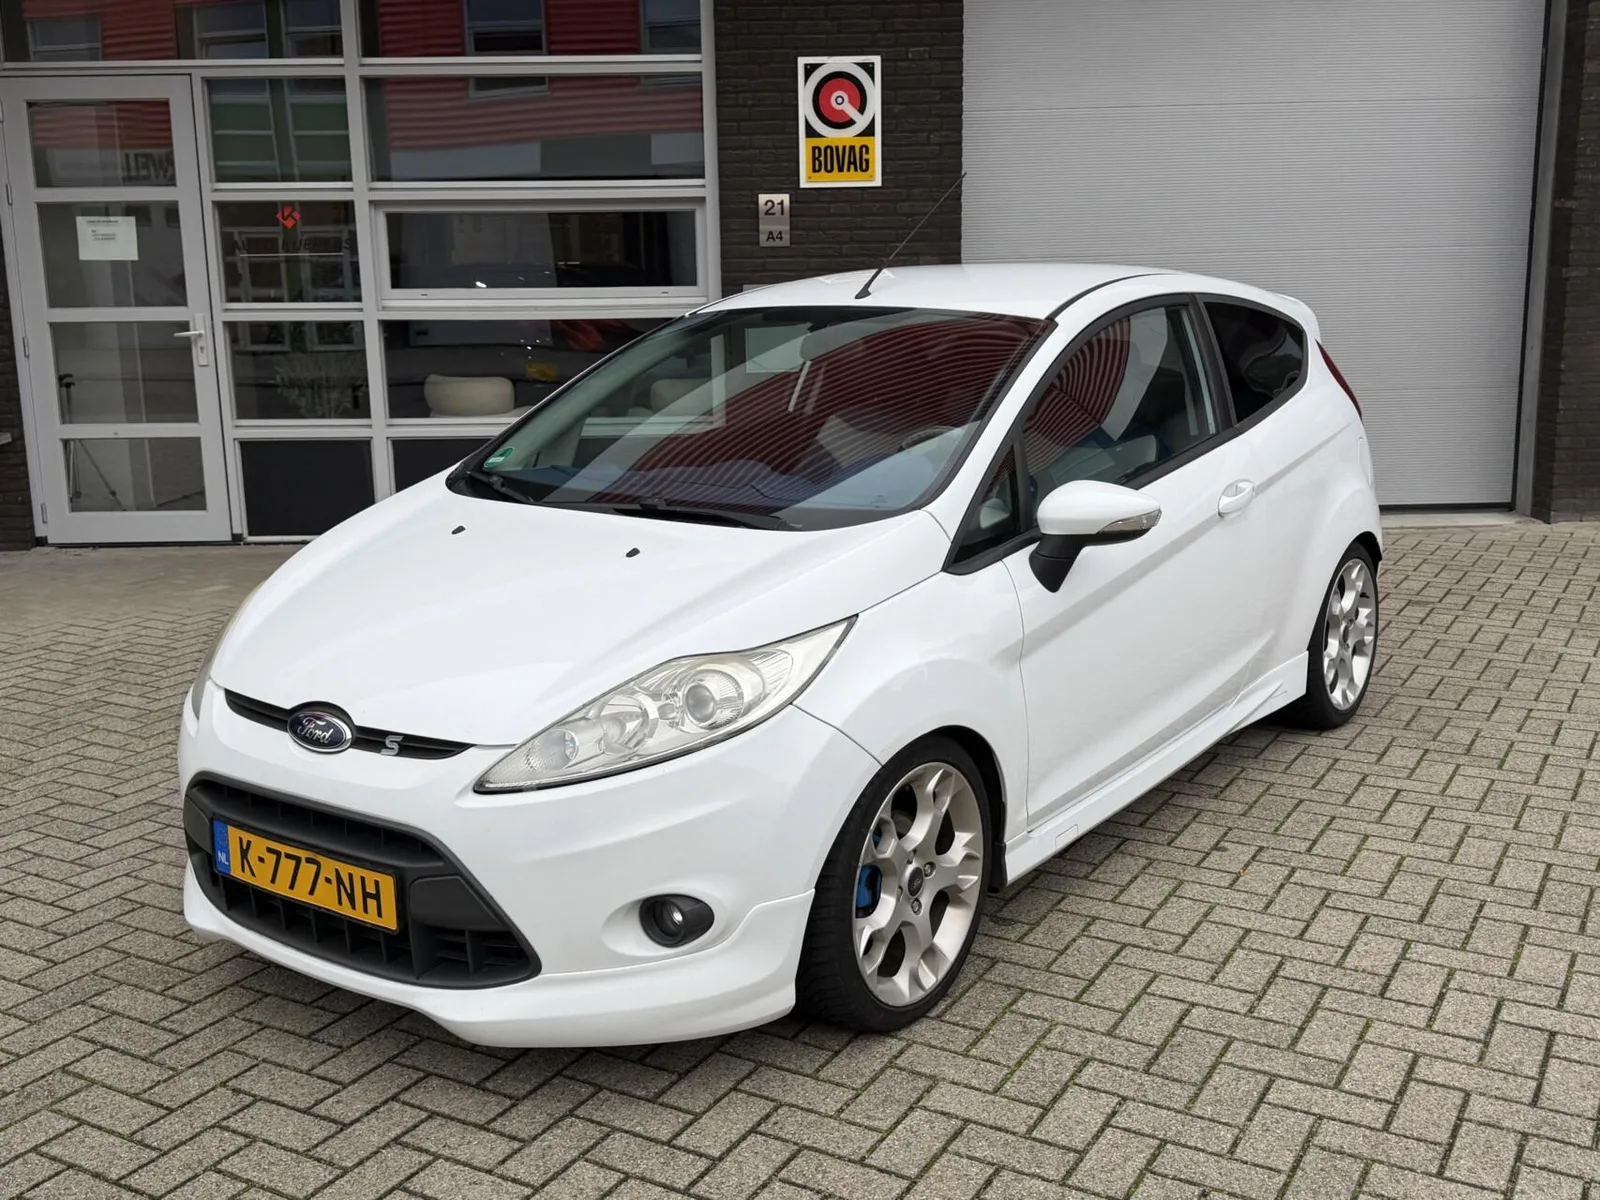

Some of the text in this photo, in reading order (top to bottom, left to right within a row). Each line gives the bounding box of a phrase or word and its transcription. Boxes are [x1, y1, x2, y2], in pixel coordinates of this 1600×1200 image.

[811, 144, 870, 174] BOVAG
[764, 199, 785, 216] 21
[765, 230, 784, 243] A4
[297, 717, 335, 744] Ford
[380, 735, 404, 756] S
[217, 850, 229, 866] NL
[238, 835, 383, 919] K-777-NH
